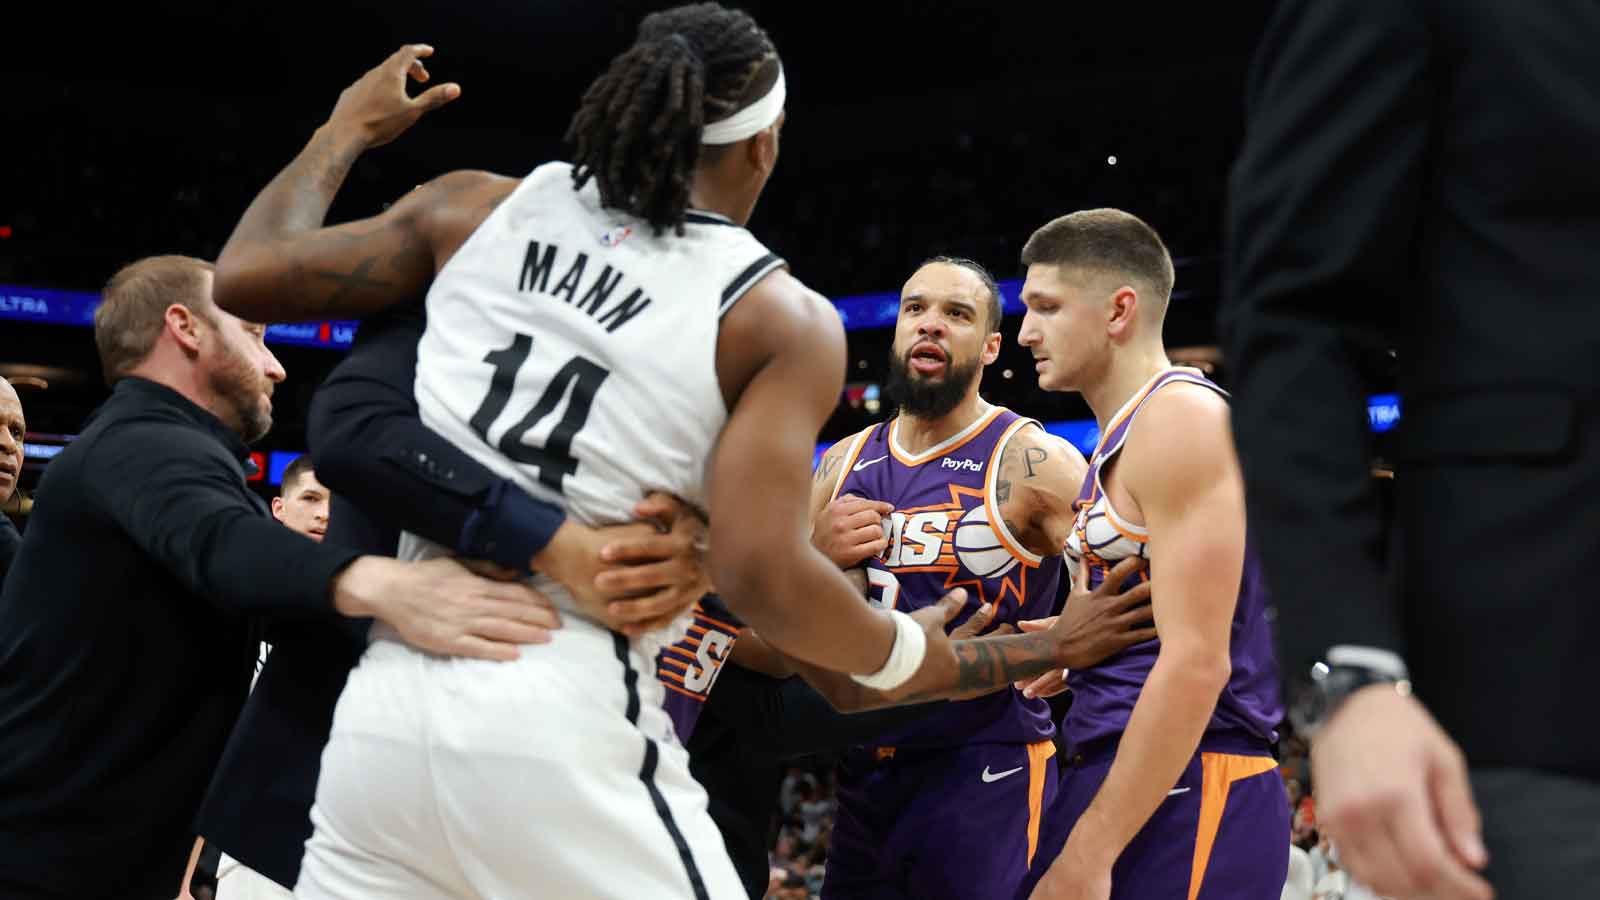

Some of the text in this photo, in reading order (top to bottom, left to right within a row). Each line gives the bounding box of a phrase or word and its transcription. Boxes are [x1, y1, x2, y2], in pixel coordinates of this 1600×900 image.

[0, 295, 49, 314] LTRA
[518, 240, 652, 334] MANN
[469, 332, 610, 494] 14
[941, 457, 984, 472] PayPal
